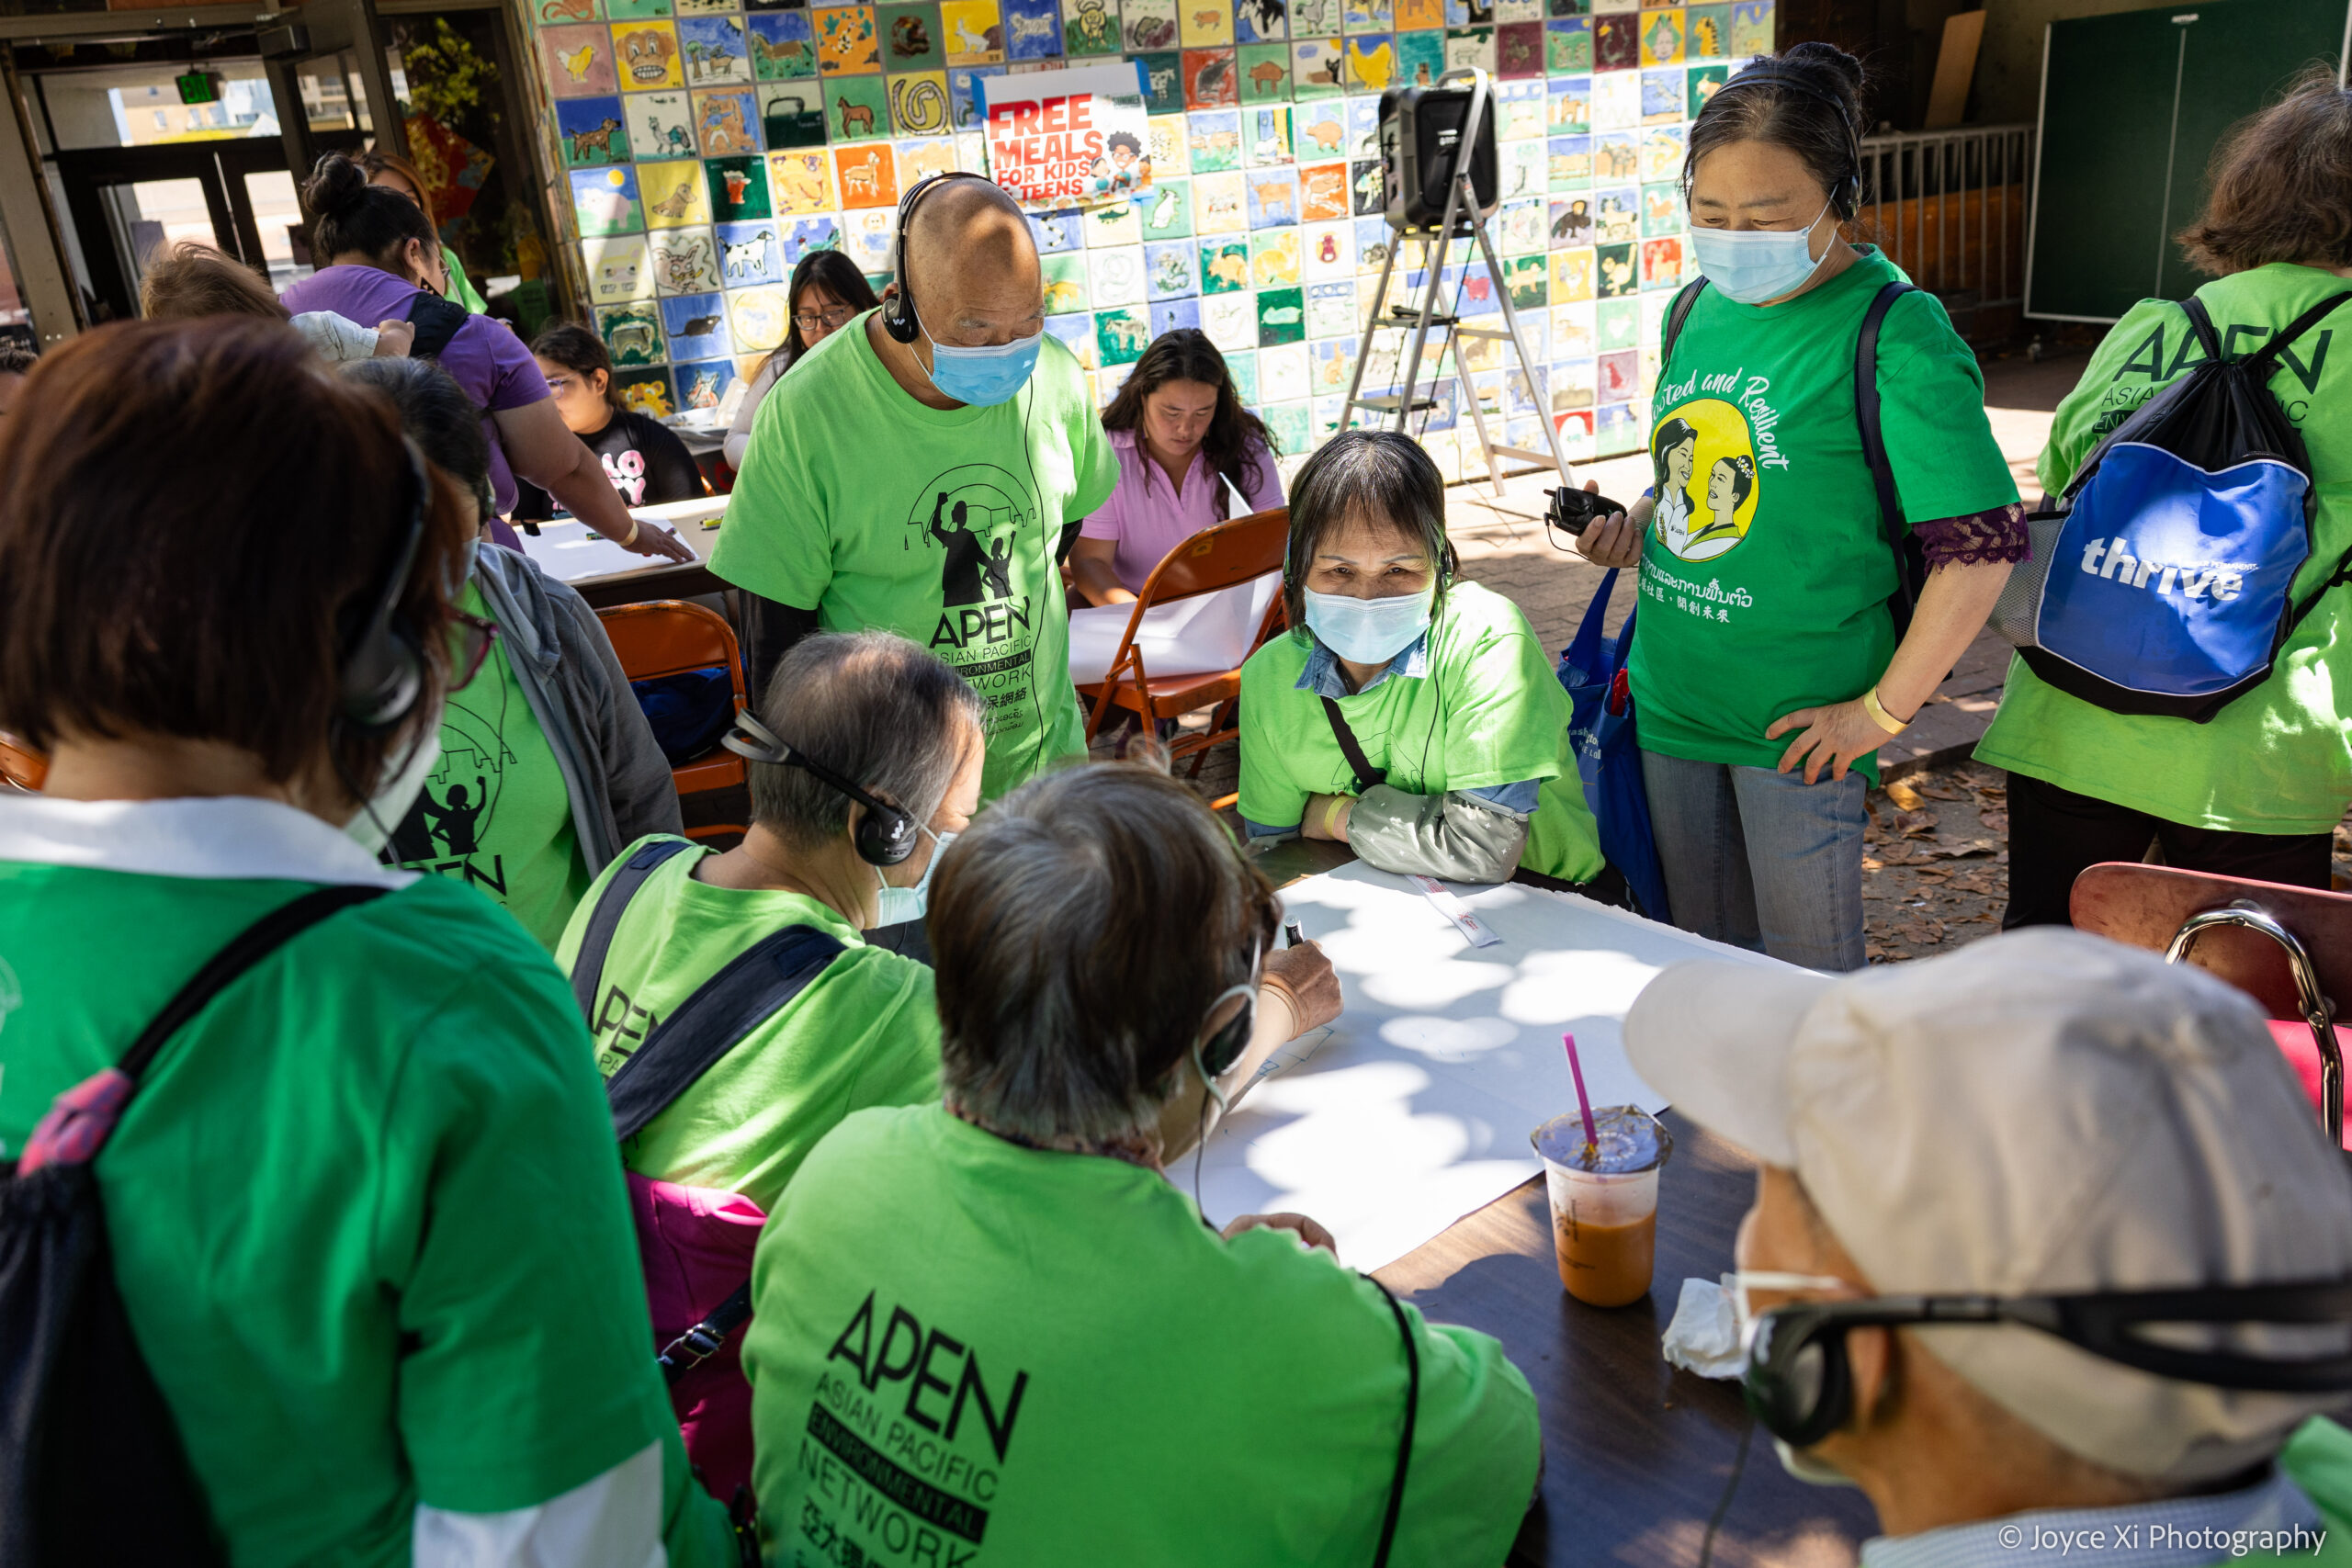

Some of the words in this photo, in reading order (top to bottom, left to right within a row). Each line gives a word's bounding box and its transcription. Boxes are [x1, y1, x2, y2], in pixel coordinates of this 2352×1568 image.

[989, 93, 1092, 140] FREE
[994, 130, 1102, 169] MEALS
[998, 167, 1035, 186] FOR
[1044, 161, 1091, 181] KIDS
[1020, 178, 1083, 200] TEENS
[2101, 387, 2154, 406] ASIA
[1652, 369, 1698, 421] ooted
[1702, 367, 1743, 394] and
[1738, 376, 1791, 471] Resilient
[2080, 536, 2244, 602] thrive
[929, 595, 1031, 649] APEN
[960, 653, 1030, 677] IRONMENTAL
[983, 635, 1032, 660] PACIFIC
[968, 664, 1031, 690] WORK
[827, 1288, 1030, 1467] APEN
[814, 1371, 882, 1438] ASIAN
[885, 1420, 999, 1503] PACIFIC
[797, 1437, 978, 1567] NETWORK
